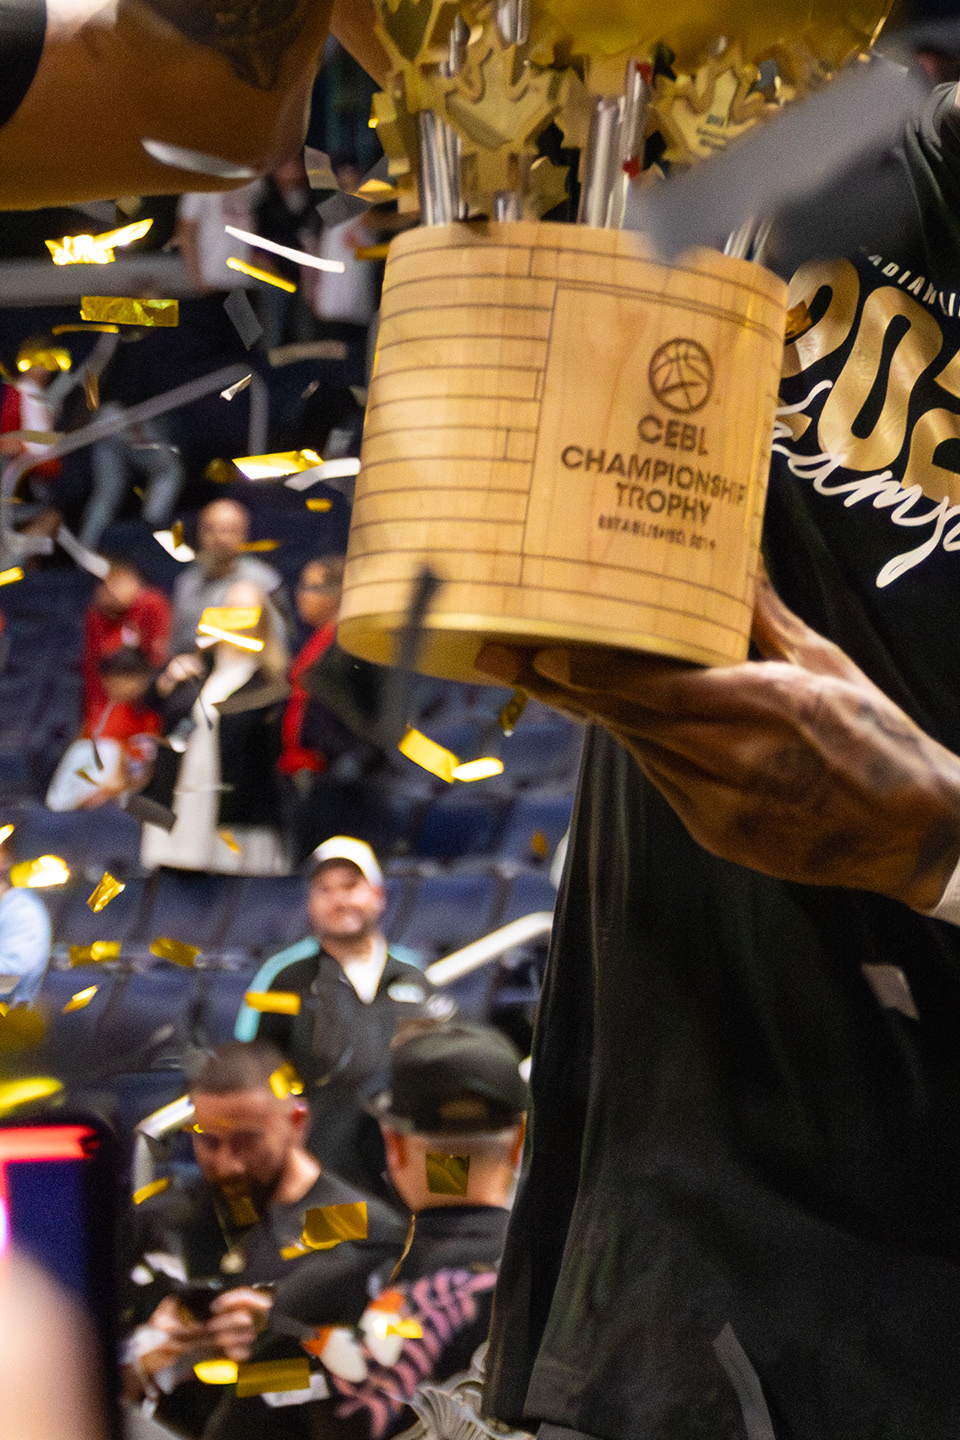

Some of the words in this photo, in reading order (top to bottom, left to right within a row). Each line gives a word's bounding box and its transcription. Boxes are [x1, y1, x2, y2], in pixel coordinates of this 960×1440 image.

[637, 414, 709, 457] CEBL
[561, 445, 747, 506] CHAMPIONSHIP
[616, 481, 712, 526] TROPHY
